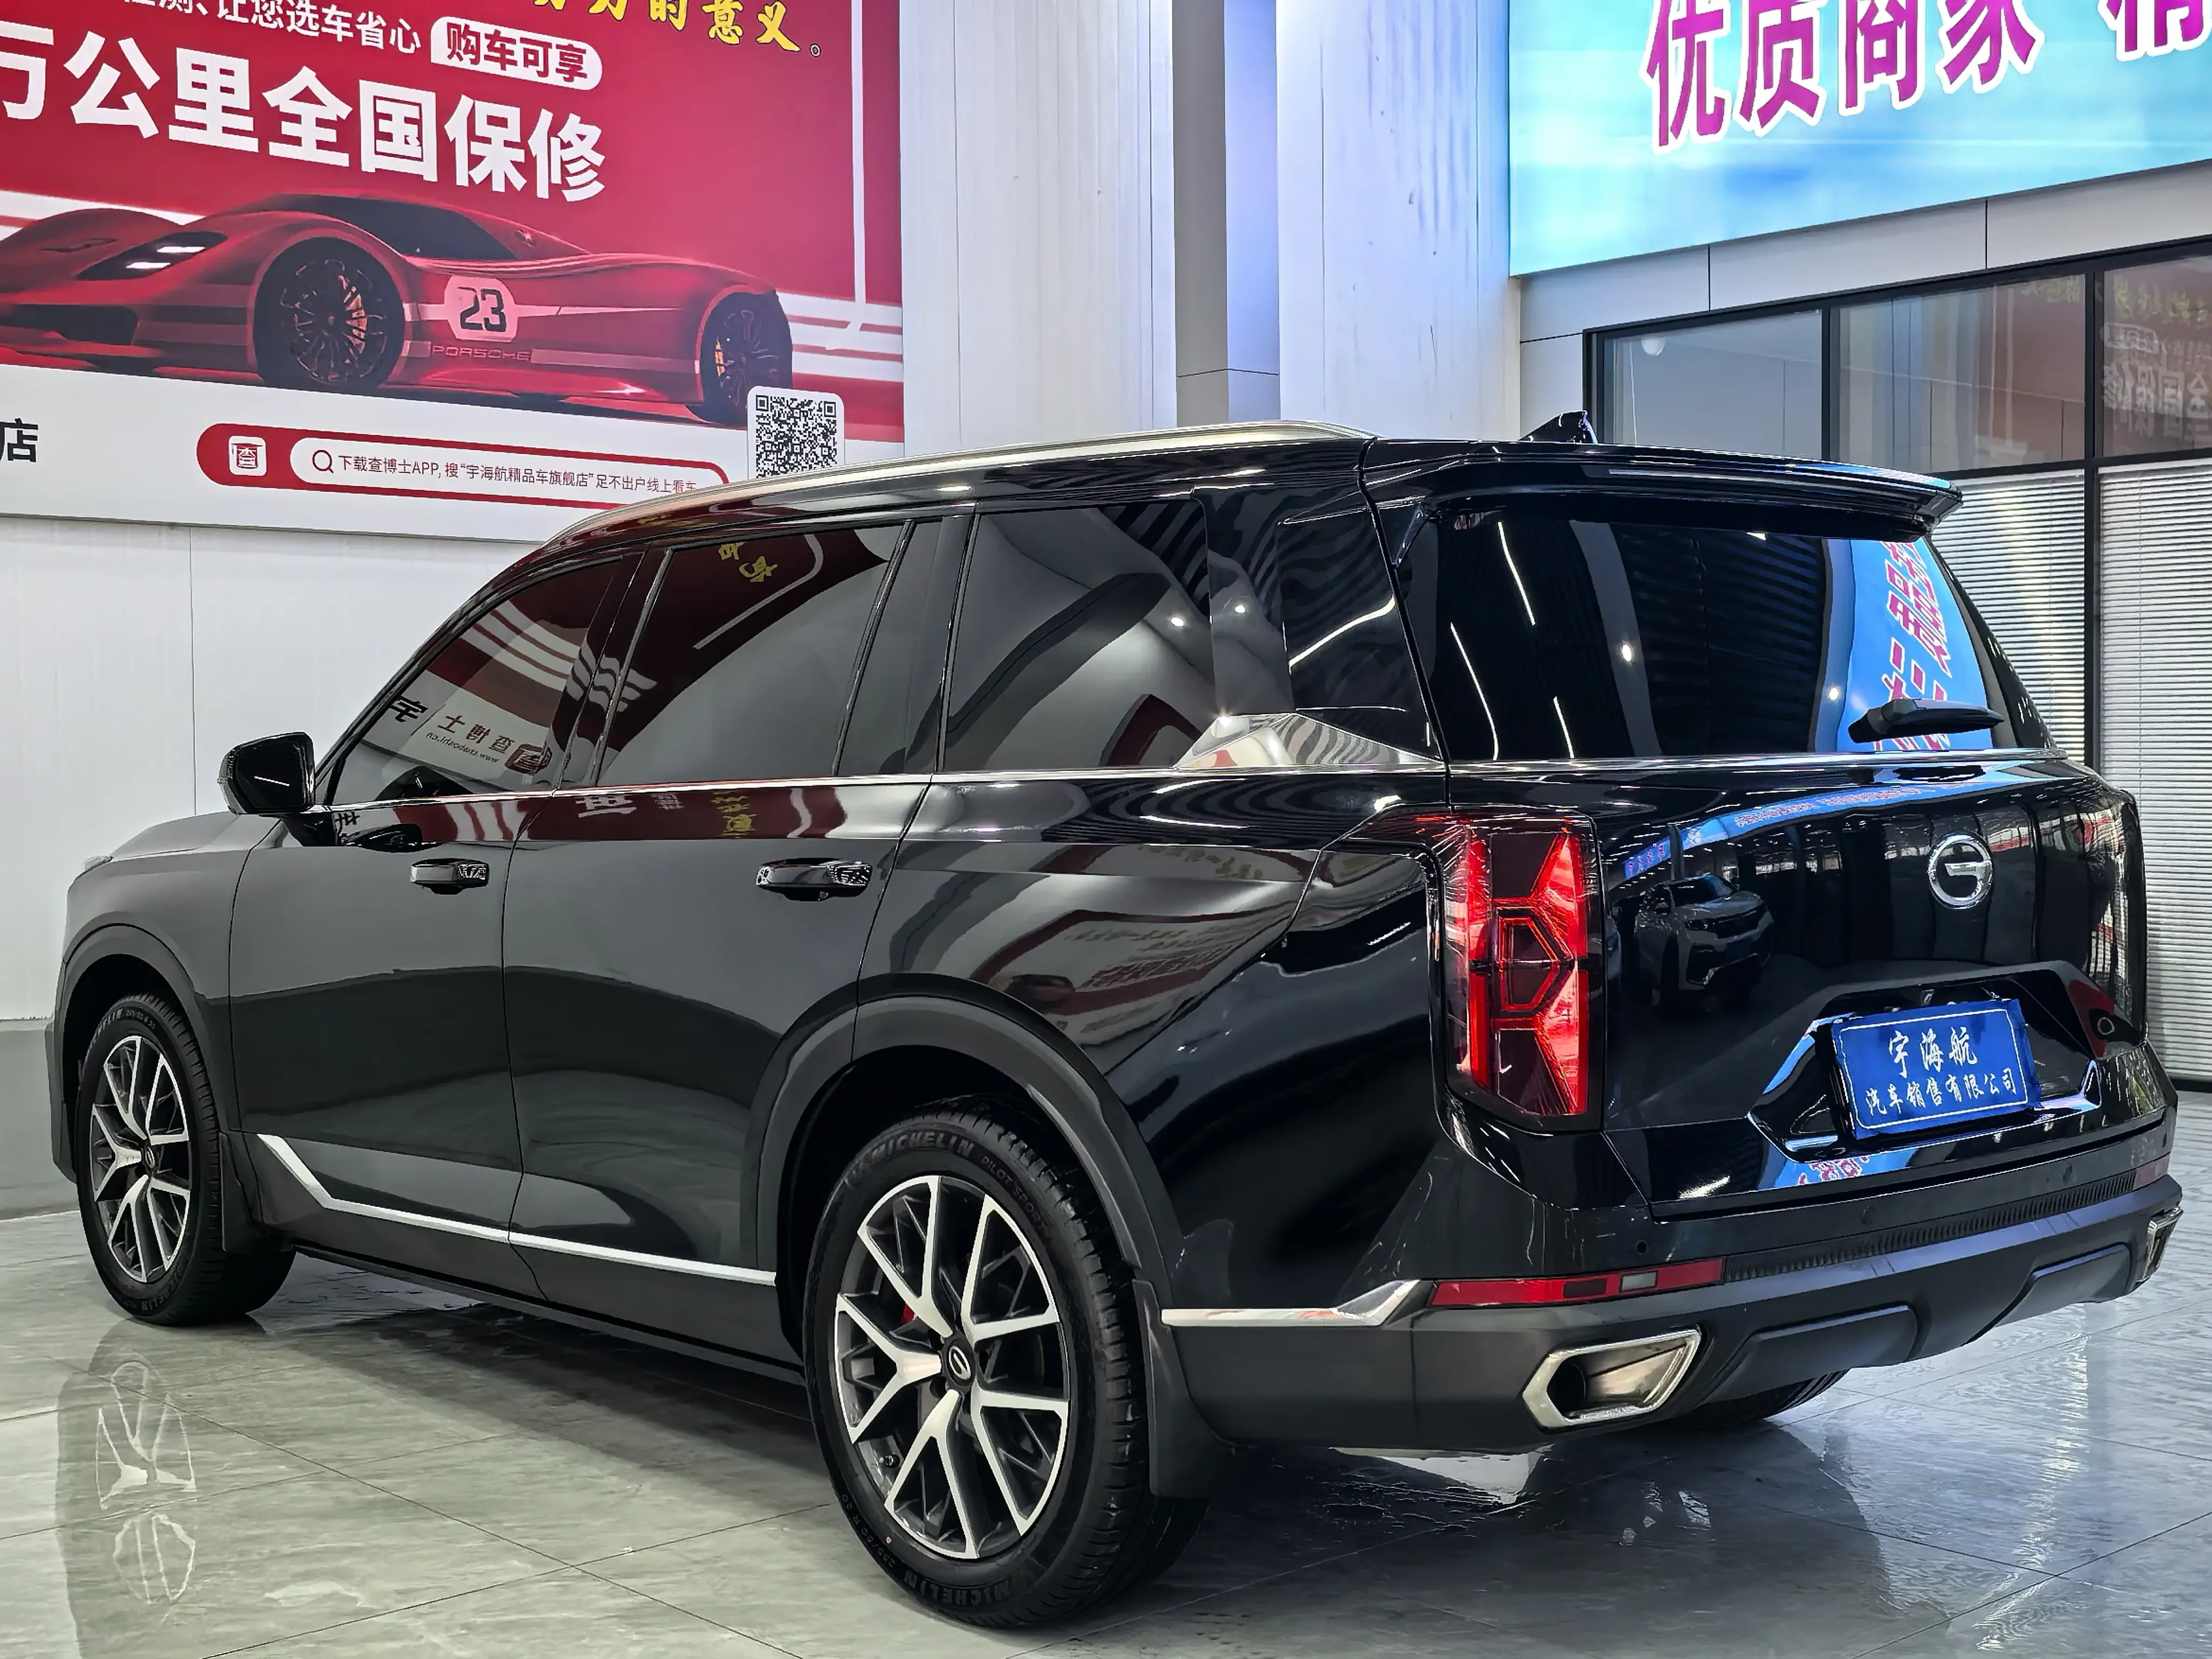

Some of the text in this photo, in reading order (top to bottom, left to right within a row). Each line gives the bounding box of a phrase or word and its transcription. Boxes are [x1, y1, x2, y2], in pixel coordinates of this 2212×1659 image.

[446, 22, 588, 83] 购车可享
[458, 287, 507, 332] 23
[433, 346, 530, 361] PORSCHE
[1889, 1026, 1978, 1078] 宇海航
[1865, 1067, 2018, 1117] 汽车销售有限公司
[871, 1131, 974, 1158] MICHELIN
[981, 1156, 1013, 1185] PILOT
[903, 1569, 1010, 1606] MICHELIN
